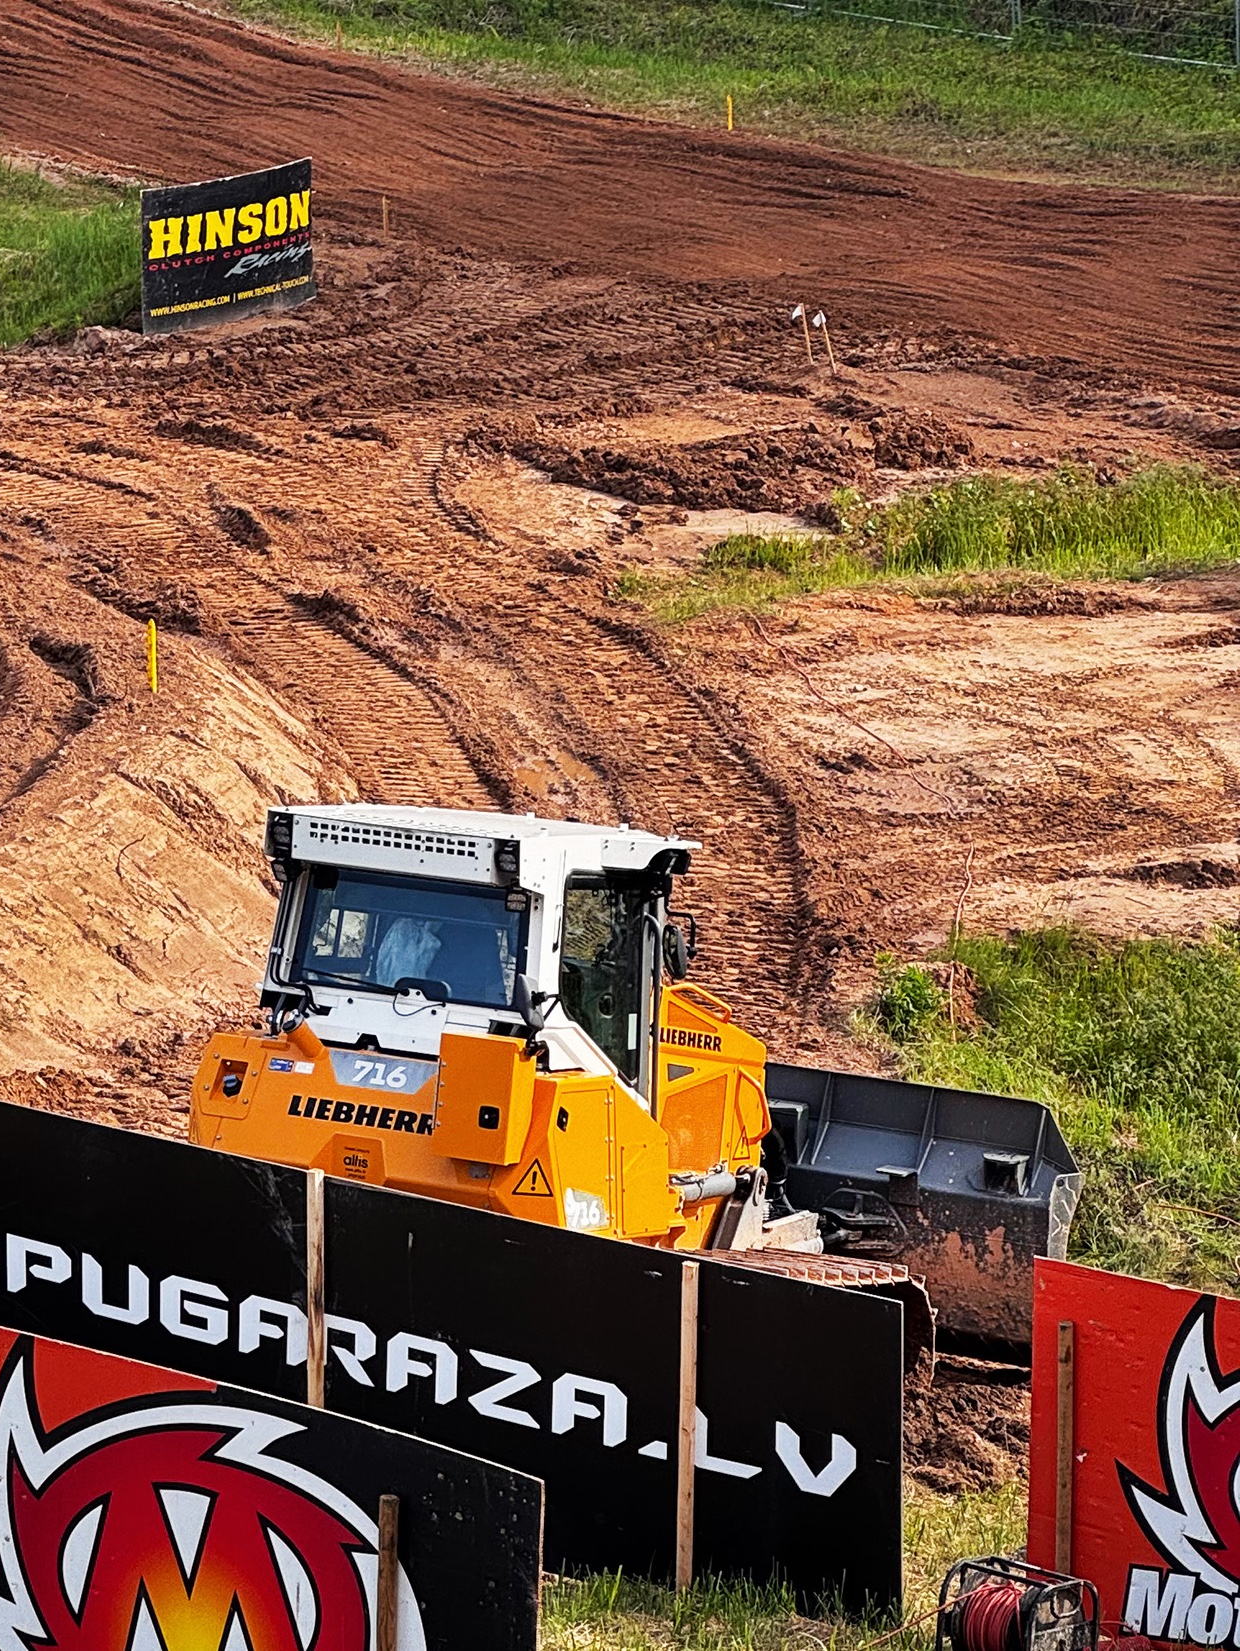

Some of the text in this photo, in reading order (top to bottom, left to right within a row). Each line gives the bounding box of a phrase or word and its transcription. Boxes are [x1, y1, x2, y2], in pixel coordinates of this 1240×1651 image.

[148, 189, 310, 260] HINSON
[148, 232, 310, 272] CLUTCH COMPONENTS
[660, 1027, 722, 1053] LIEBHERR
[352, 1060, 407, 1089] 716
[288, 1095, 434, 1136] LIEBHERR
